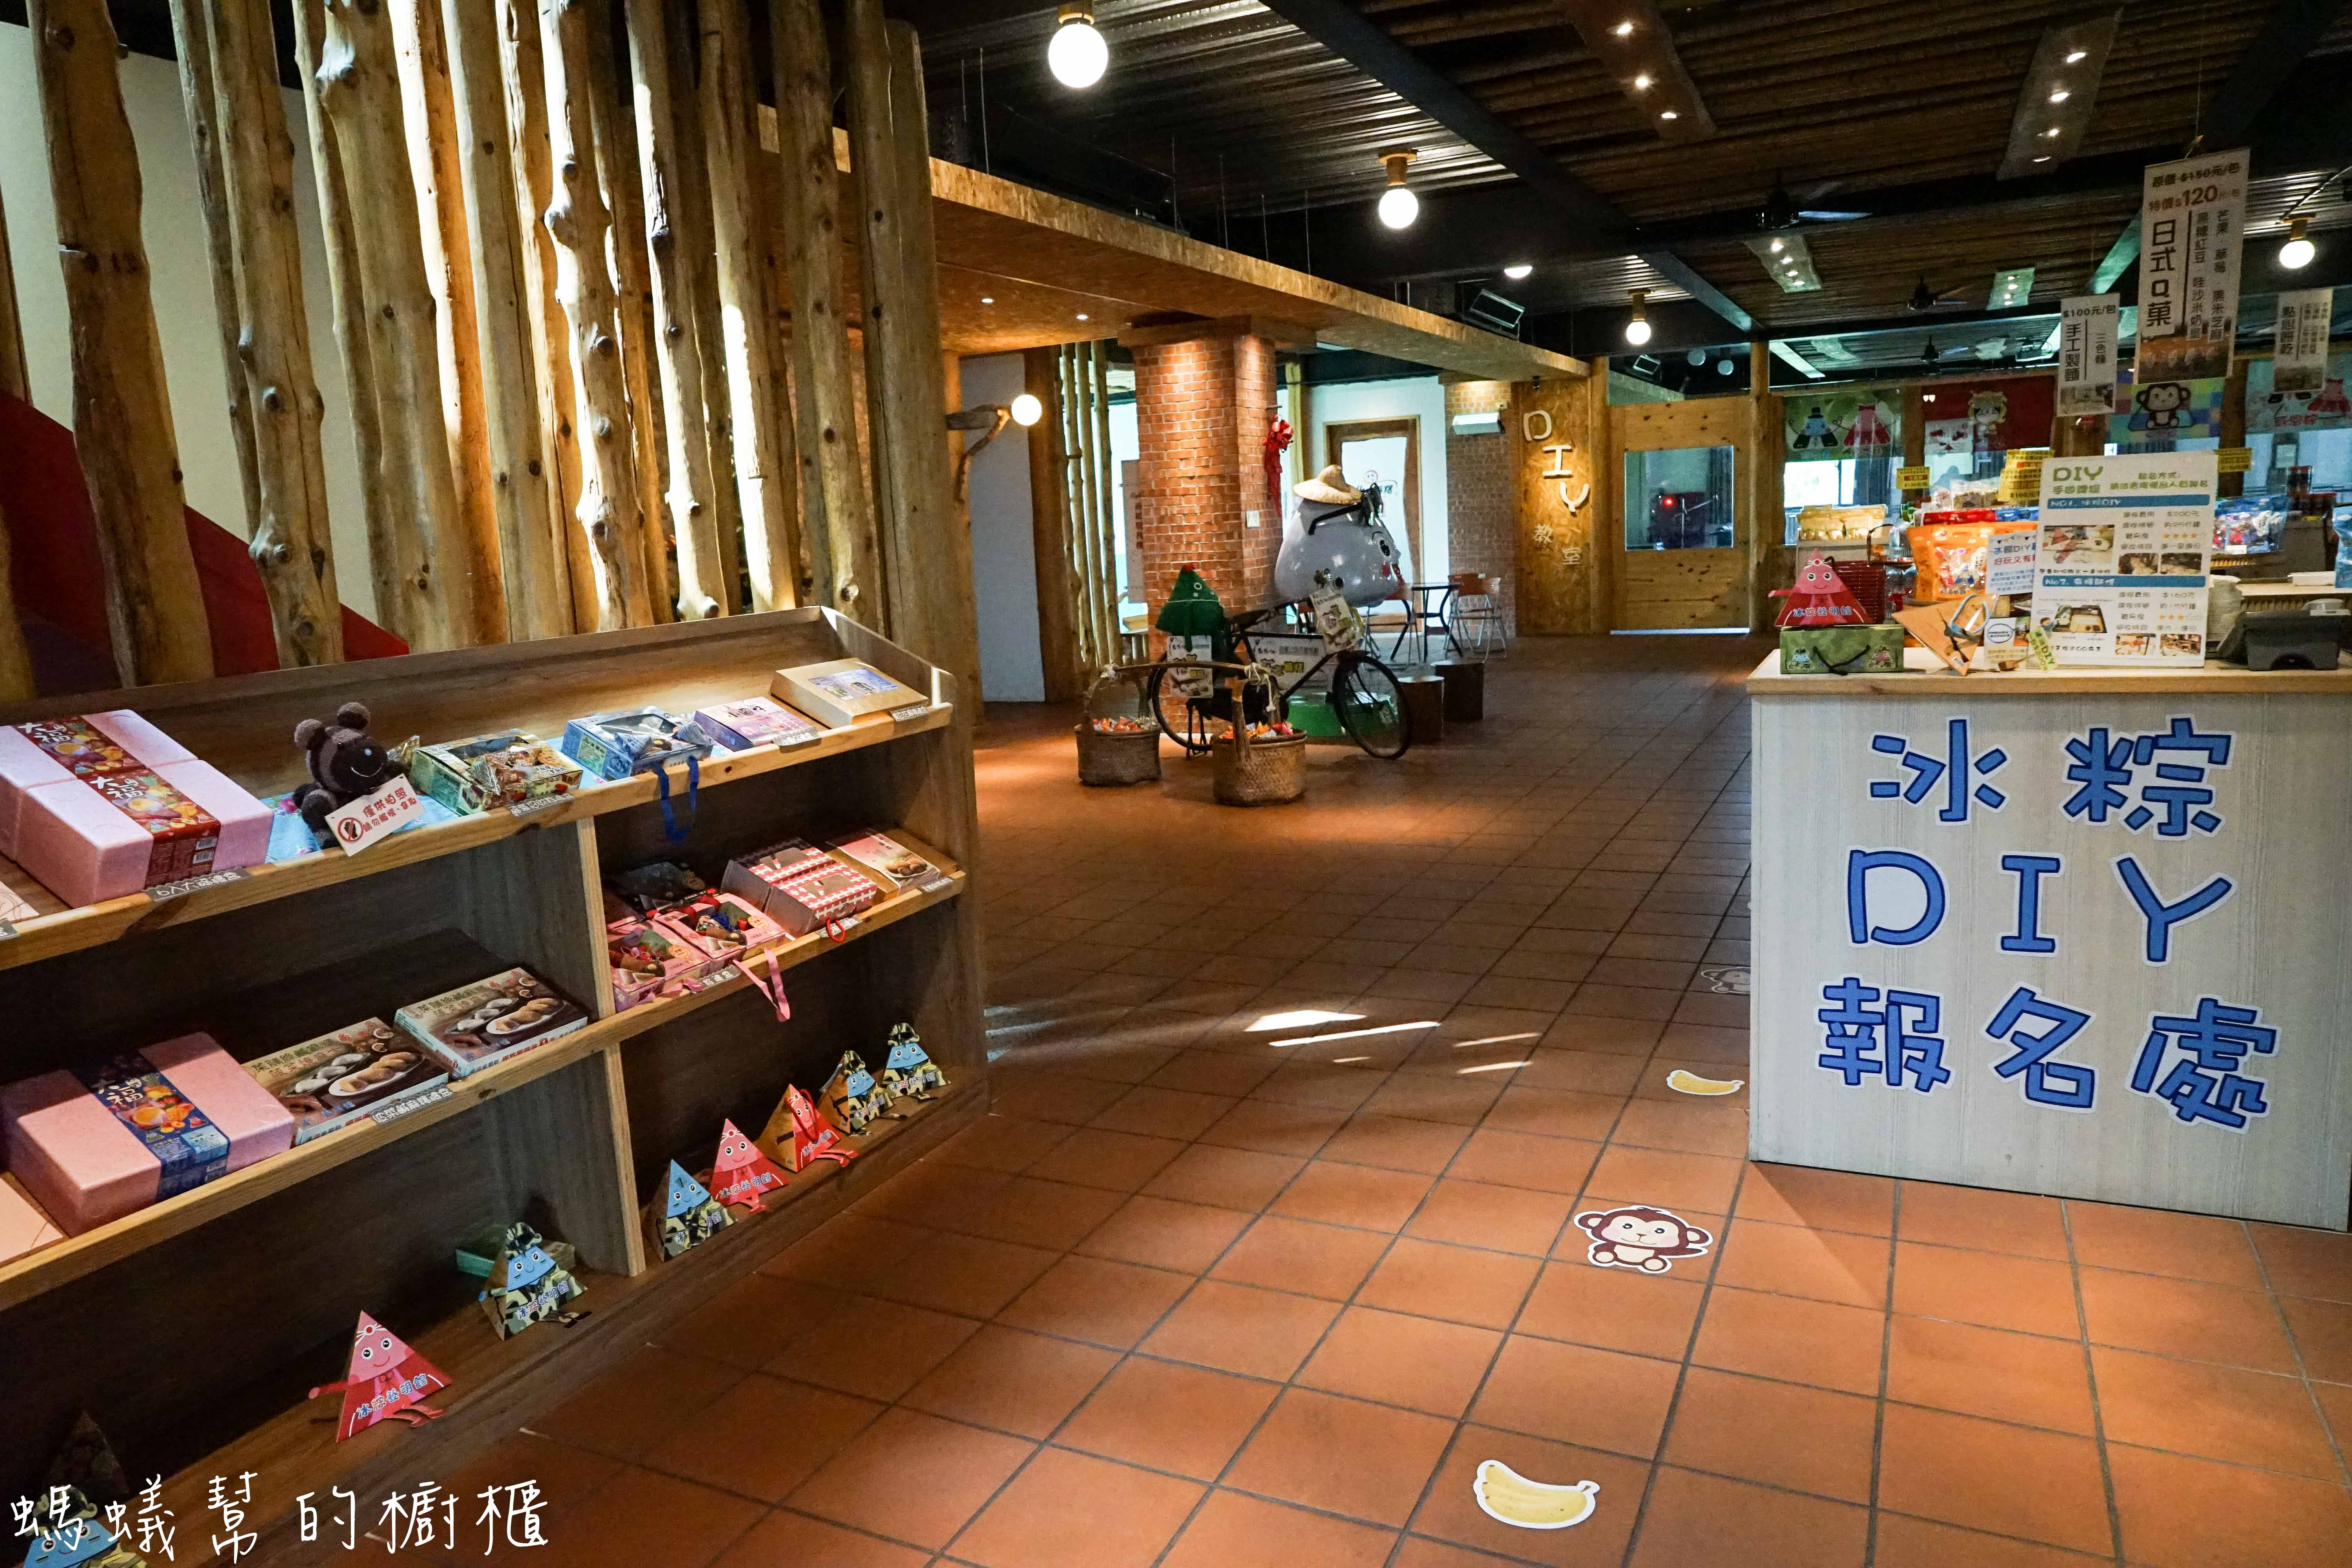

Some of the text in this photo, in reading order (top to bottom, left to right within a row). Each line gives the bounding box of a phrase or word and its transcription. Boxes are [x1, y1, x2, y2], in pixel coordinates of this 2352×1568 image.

[1523, 410, 1589, 513] DIY
[2053, 466, 2103, 481] DIY
[1533, 524, 1581, 566] 教室
[89, 775, 145, 799] 大福
[1869, 717, 2232, 836] 冰粽
[1847, 849, 2233, 963] DIY
[1818, 978, 2277, 1129] 報名處
